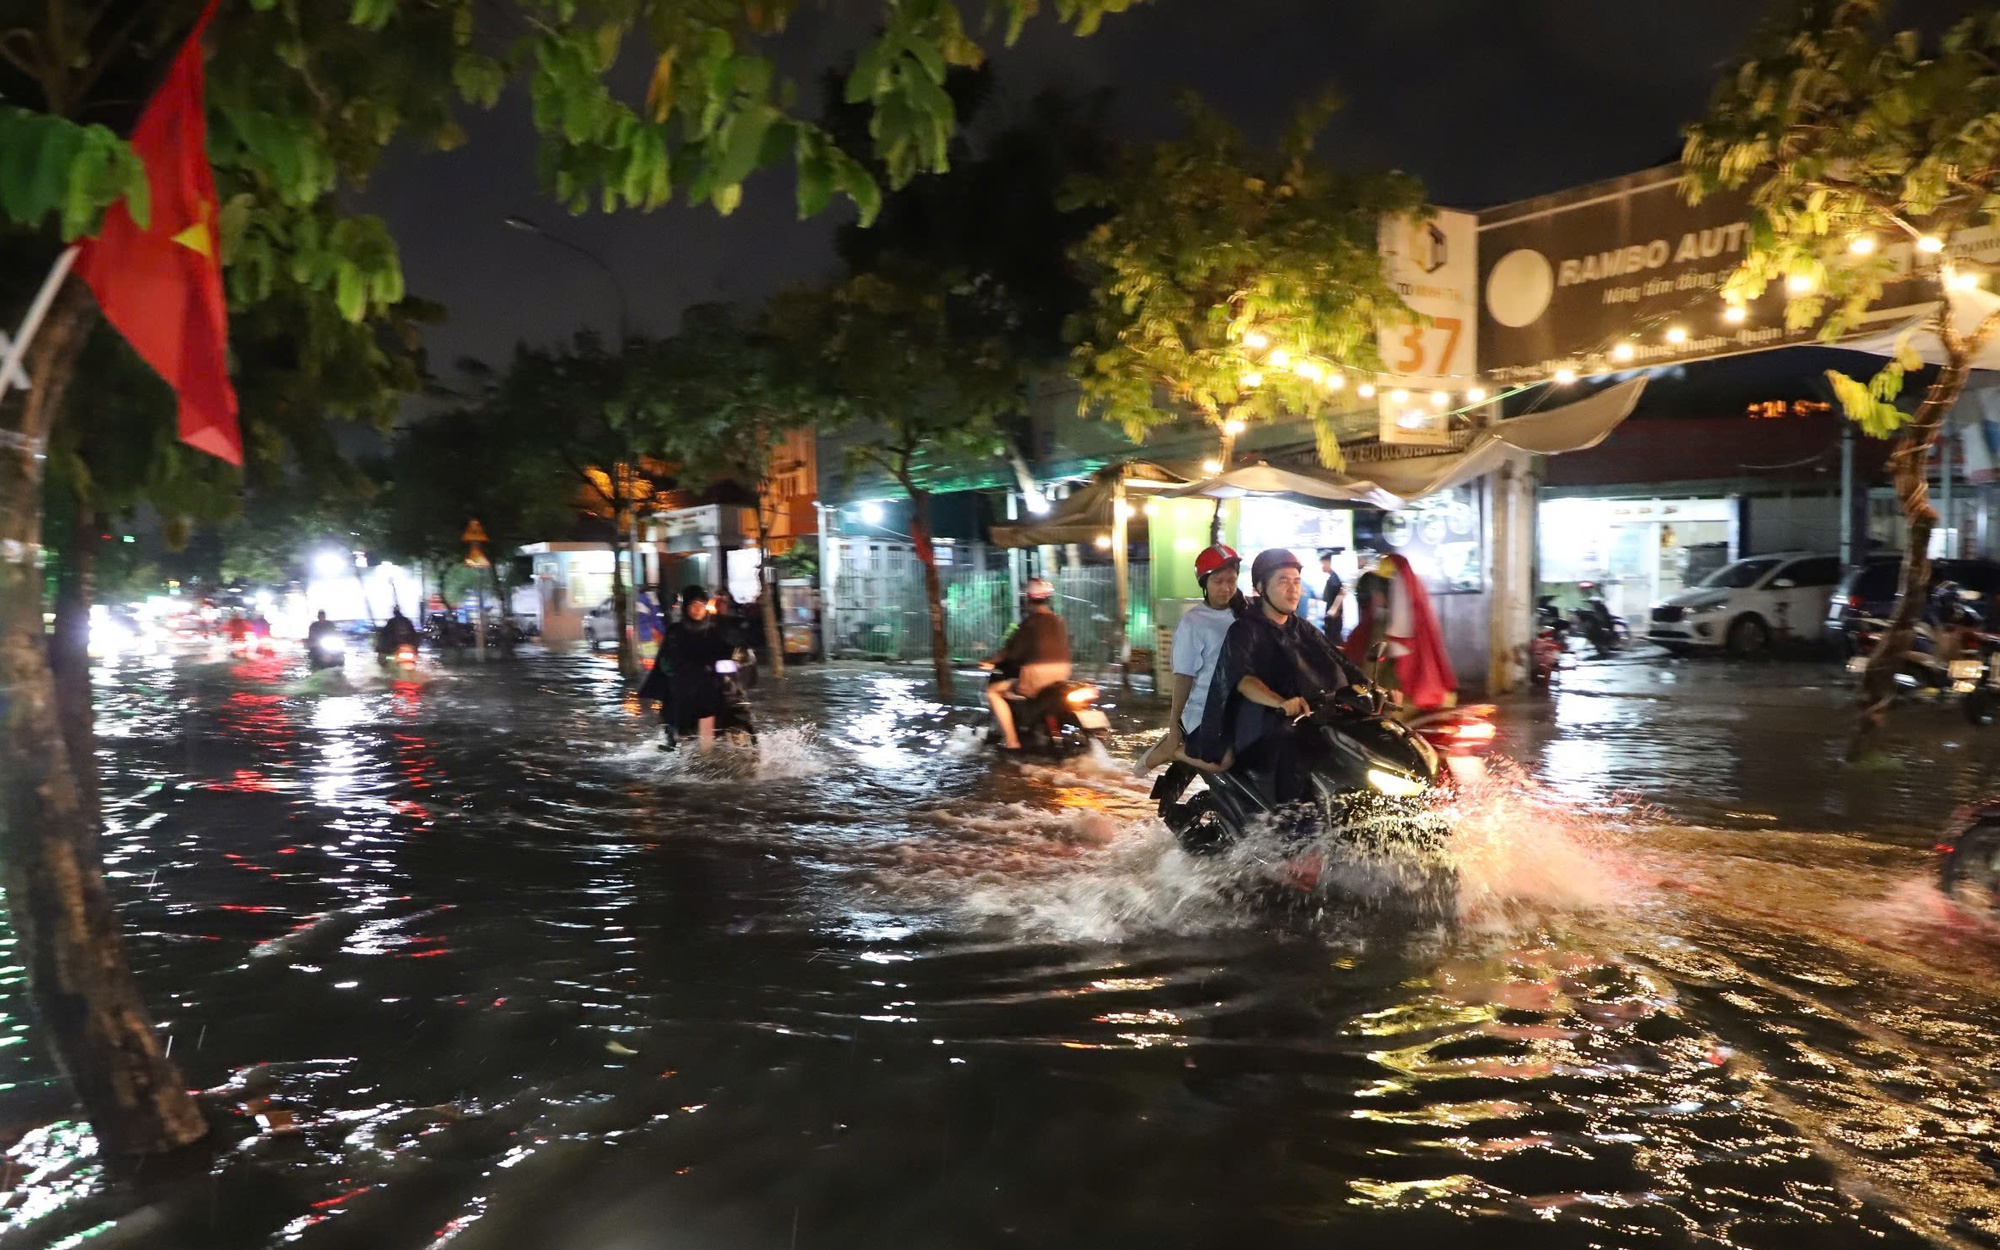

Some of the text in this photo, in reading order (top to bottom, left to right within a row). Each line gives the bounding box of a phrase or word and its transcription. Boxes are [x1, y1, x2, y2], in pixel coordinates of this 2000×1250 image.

[1557, 239, 1670, 286] RAMBO
[1673, 221, 1753, 263] AUT
[1397, 315, 1462, 375] 37
